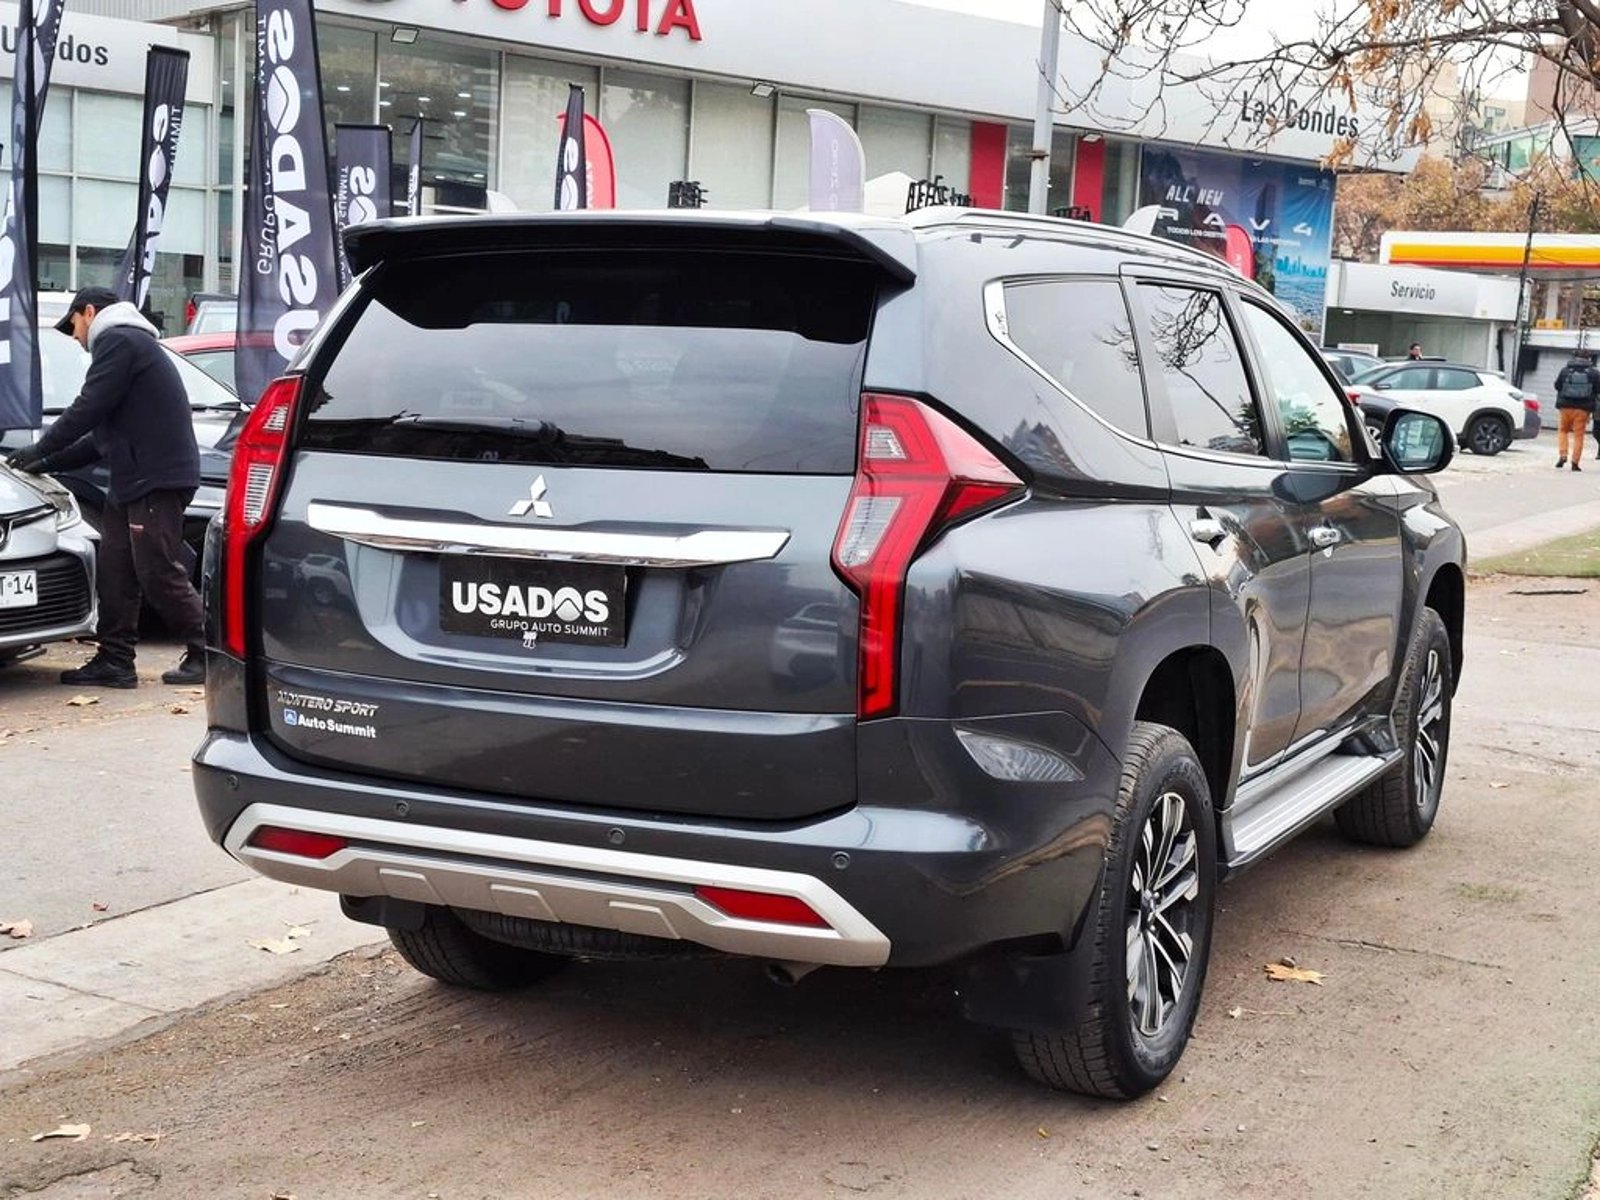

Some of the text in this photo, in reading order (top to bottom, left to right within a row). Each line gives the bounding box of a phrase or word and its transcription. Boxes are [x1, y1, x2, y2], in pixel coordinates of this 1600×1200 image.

[1, 25, 109, 66] Udos
[1285, 99, 1359, 138] Condes
[1165, 184, 1225, 207] ALL NEW
[1390, 280, 1436, 301] Servicio
[452, 581, 609, 623] USADOS
[490, 618, 609, 637] GRUPO AUTO SUMMIT
[333, 699, 379, 717] SPORT
